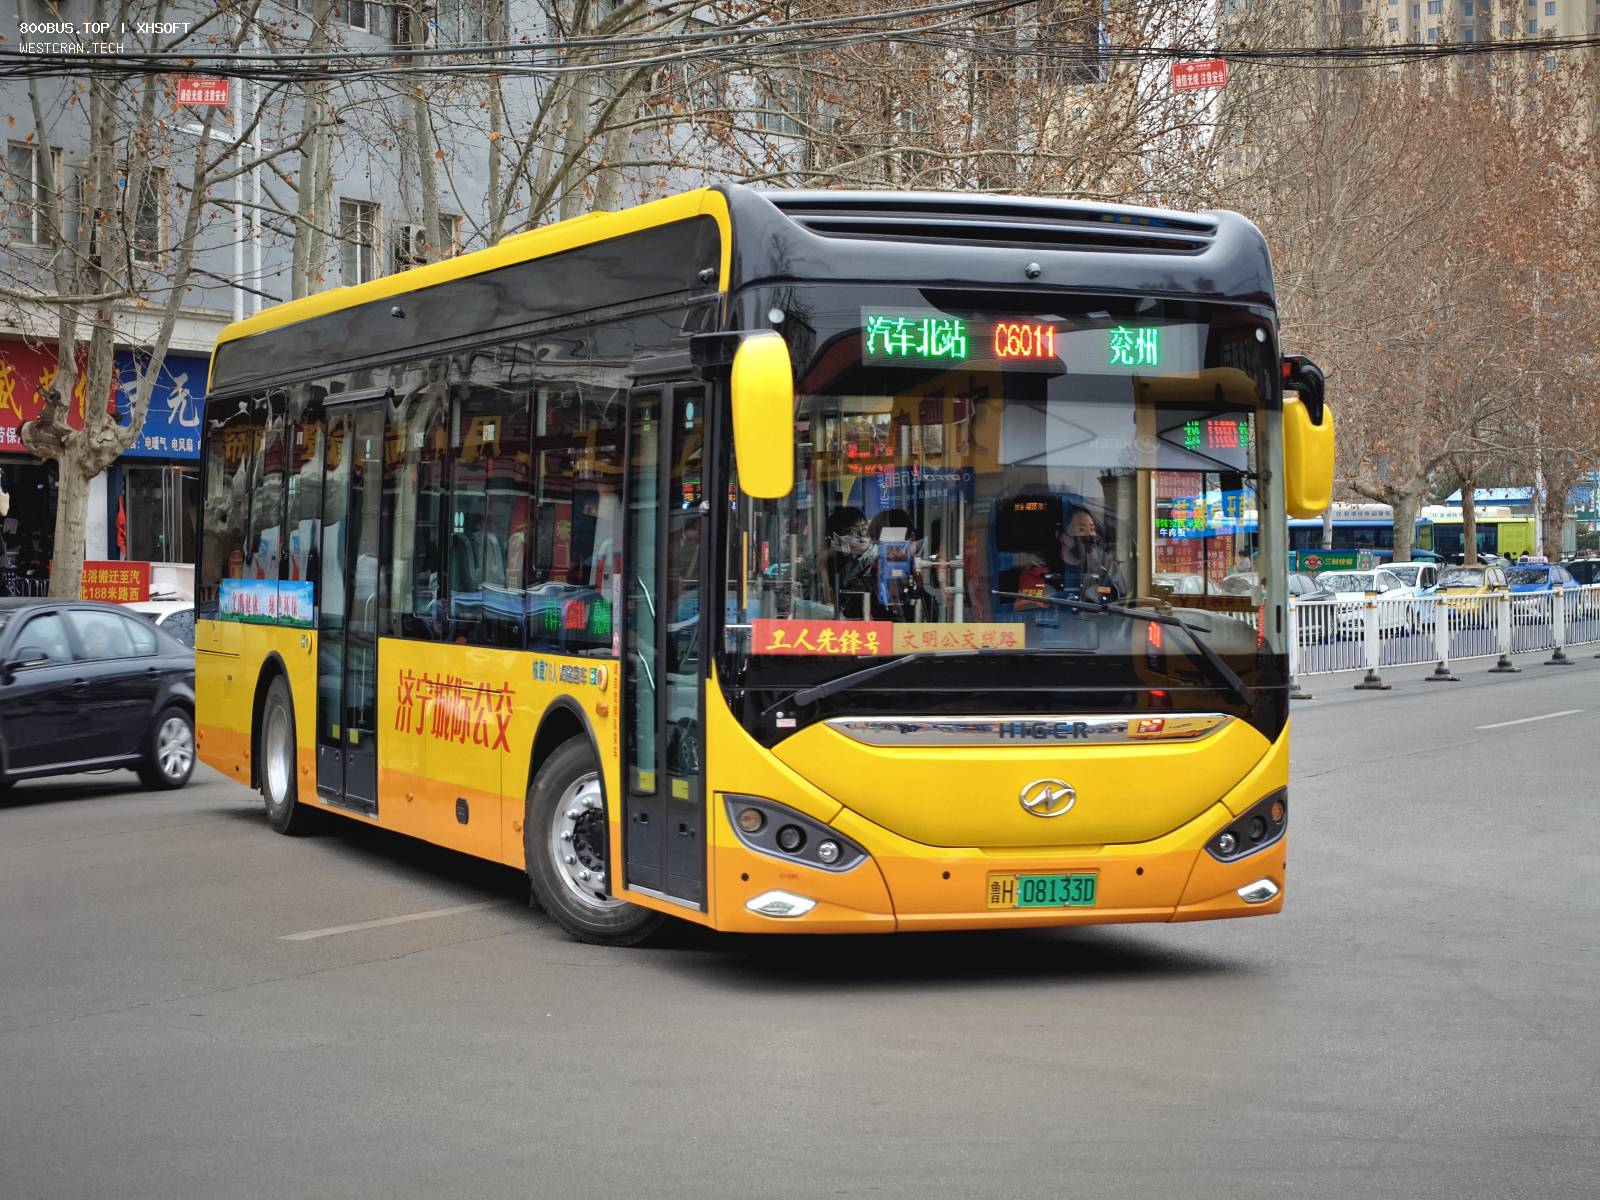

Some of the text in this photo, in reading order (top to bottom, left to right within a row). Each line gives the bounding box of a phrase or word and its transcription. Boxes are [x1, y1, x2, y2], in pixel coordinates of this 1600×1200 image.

[866, 315, 966, 358] 汽车北站
[995, 323, 1055, 357] C6011
[1109, 326, 1158, 365] 兖州
[766, 628, 880, 655] 工人先锋号
[901, 630, 1018, 650] 文明公交线路
[395, 669, 515, 753] 济宁城际公交
[1000, 721, 1088, 739] HIGER
[991, 878, 1095, 904] 鲁H 08133D
